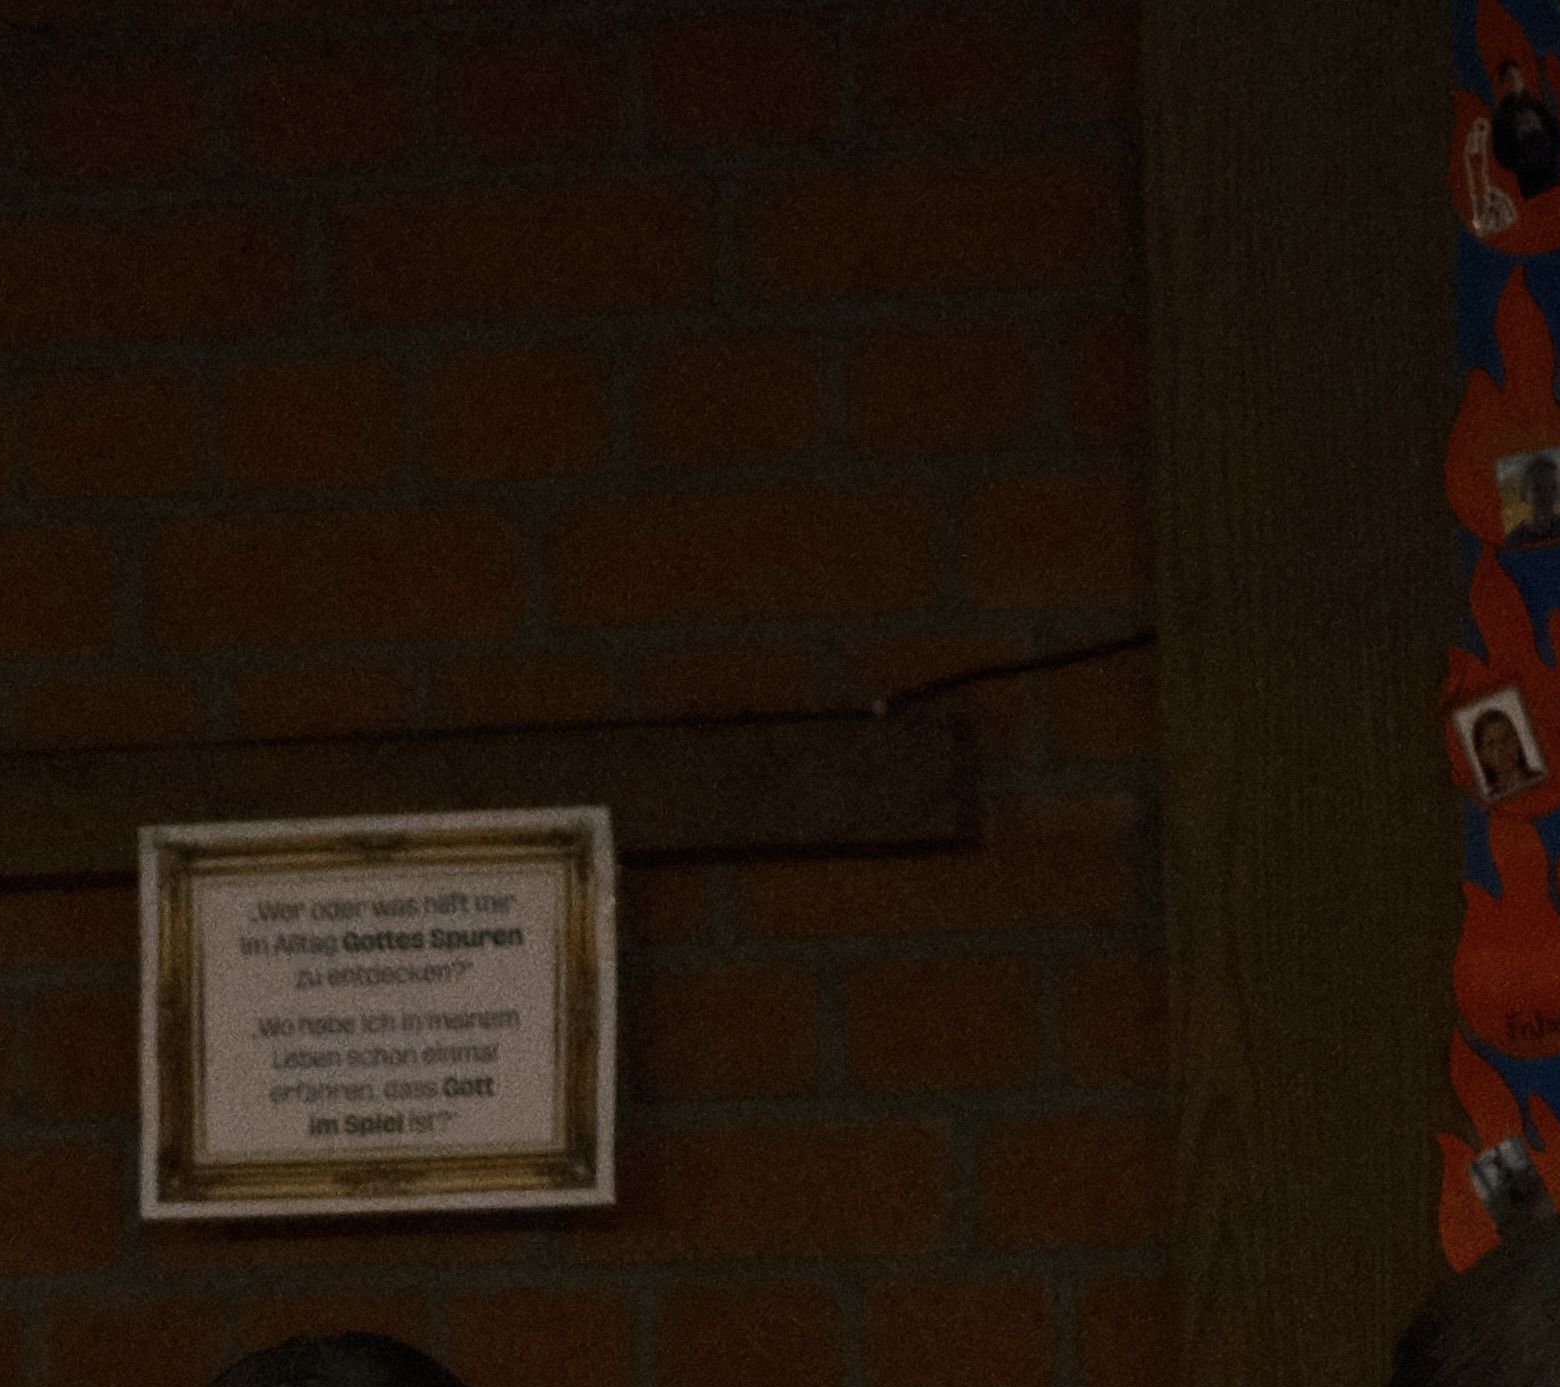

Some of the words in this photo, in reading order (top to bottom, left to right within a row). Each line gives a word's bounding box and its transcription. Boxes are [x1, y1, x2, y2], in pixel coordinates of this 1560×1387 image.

[310, 899, 365, 919] oder
[372, 897, 418, 917] was
[274, 932, 337, 957] Alltag
[342, 929, 424, 953] Gottes
[430, 926, 524, 952] Spuren
[296, 967, 323, 990] zu
[299, 1015, 356, 1036] habe
[361, 1013, 396, 1034] ich
[401, 1013, 422, 1033] in
[427, 1009, 520, 1032] meinem
[272, 1047, 342, 1071] Leben
[347, 1045, 417, 1067] schon
[422, 1042, 499, 1065] einmal
[383, 1078, 438, 1100] dass
[442, 1075, 495, 1098] Gott
[310, 1114, 339, 1136] im
[344, 1112, 405, 1137] Spiel
